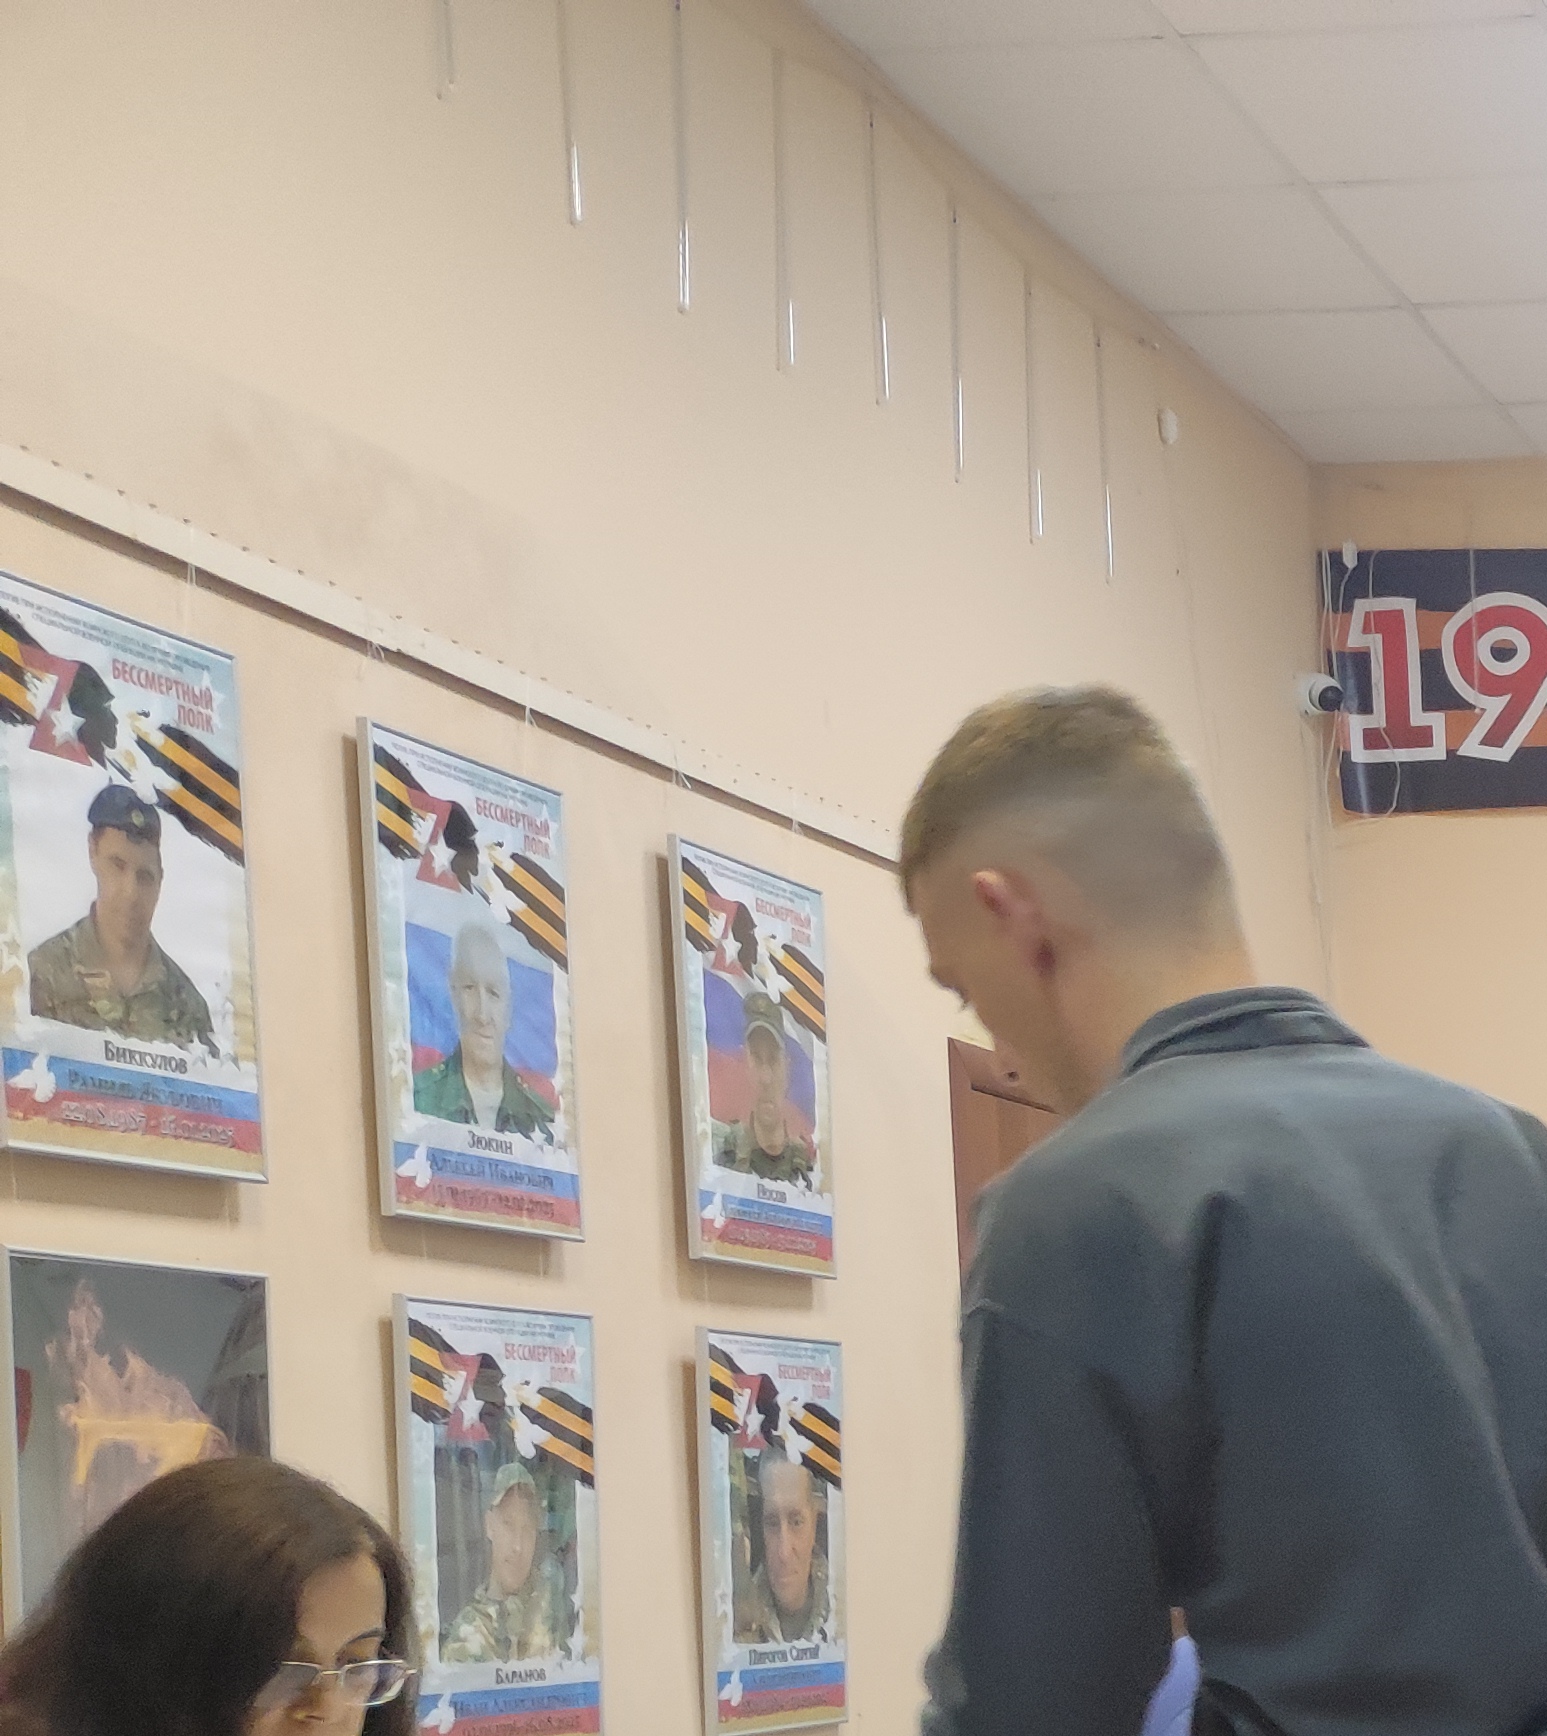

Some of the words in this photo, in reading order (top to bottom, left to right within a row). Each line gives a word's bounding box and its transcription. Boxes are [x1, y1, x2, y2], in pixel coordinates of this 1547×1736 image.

[112, 658, 213, 711] БЕССМЕРТНЫЙ
[178, 704, 214, 735] ПОЛК
[475, 797, 551, 841] БЕССМЕРТНЫЙ
[505, 1342, 576, 1364] БЕССМЕРТНЫЙ
